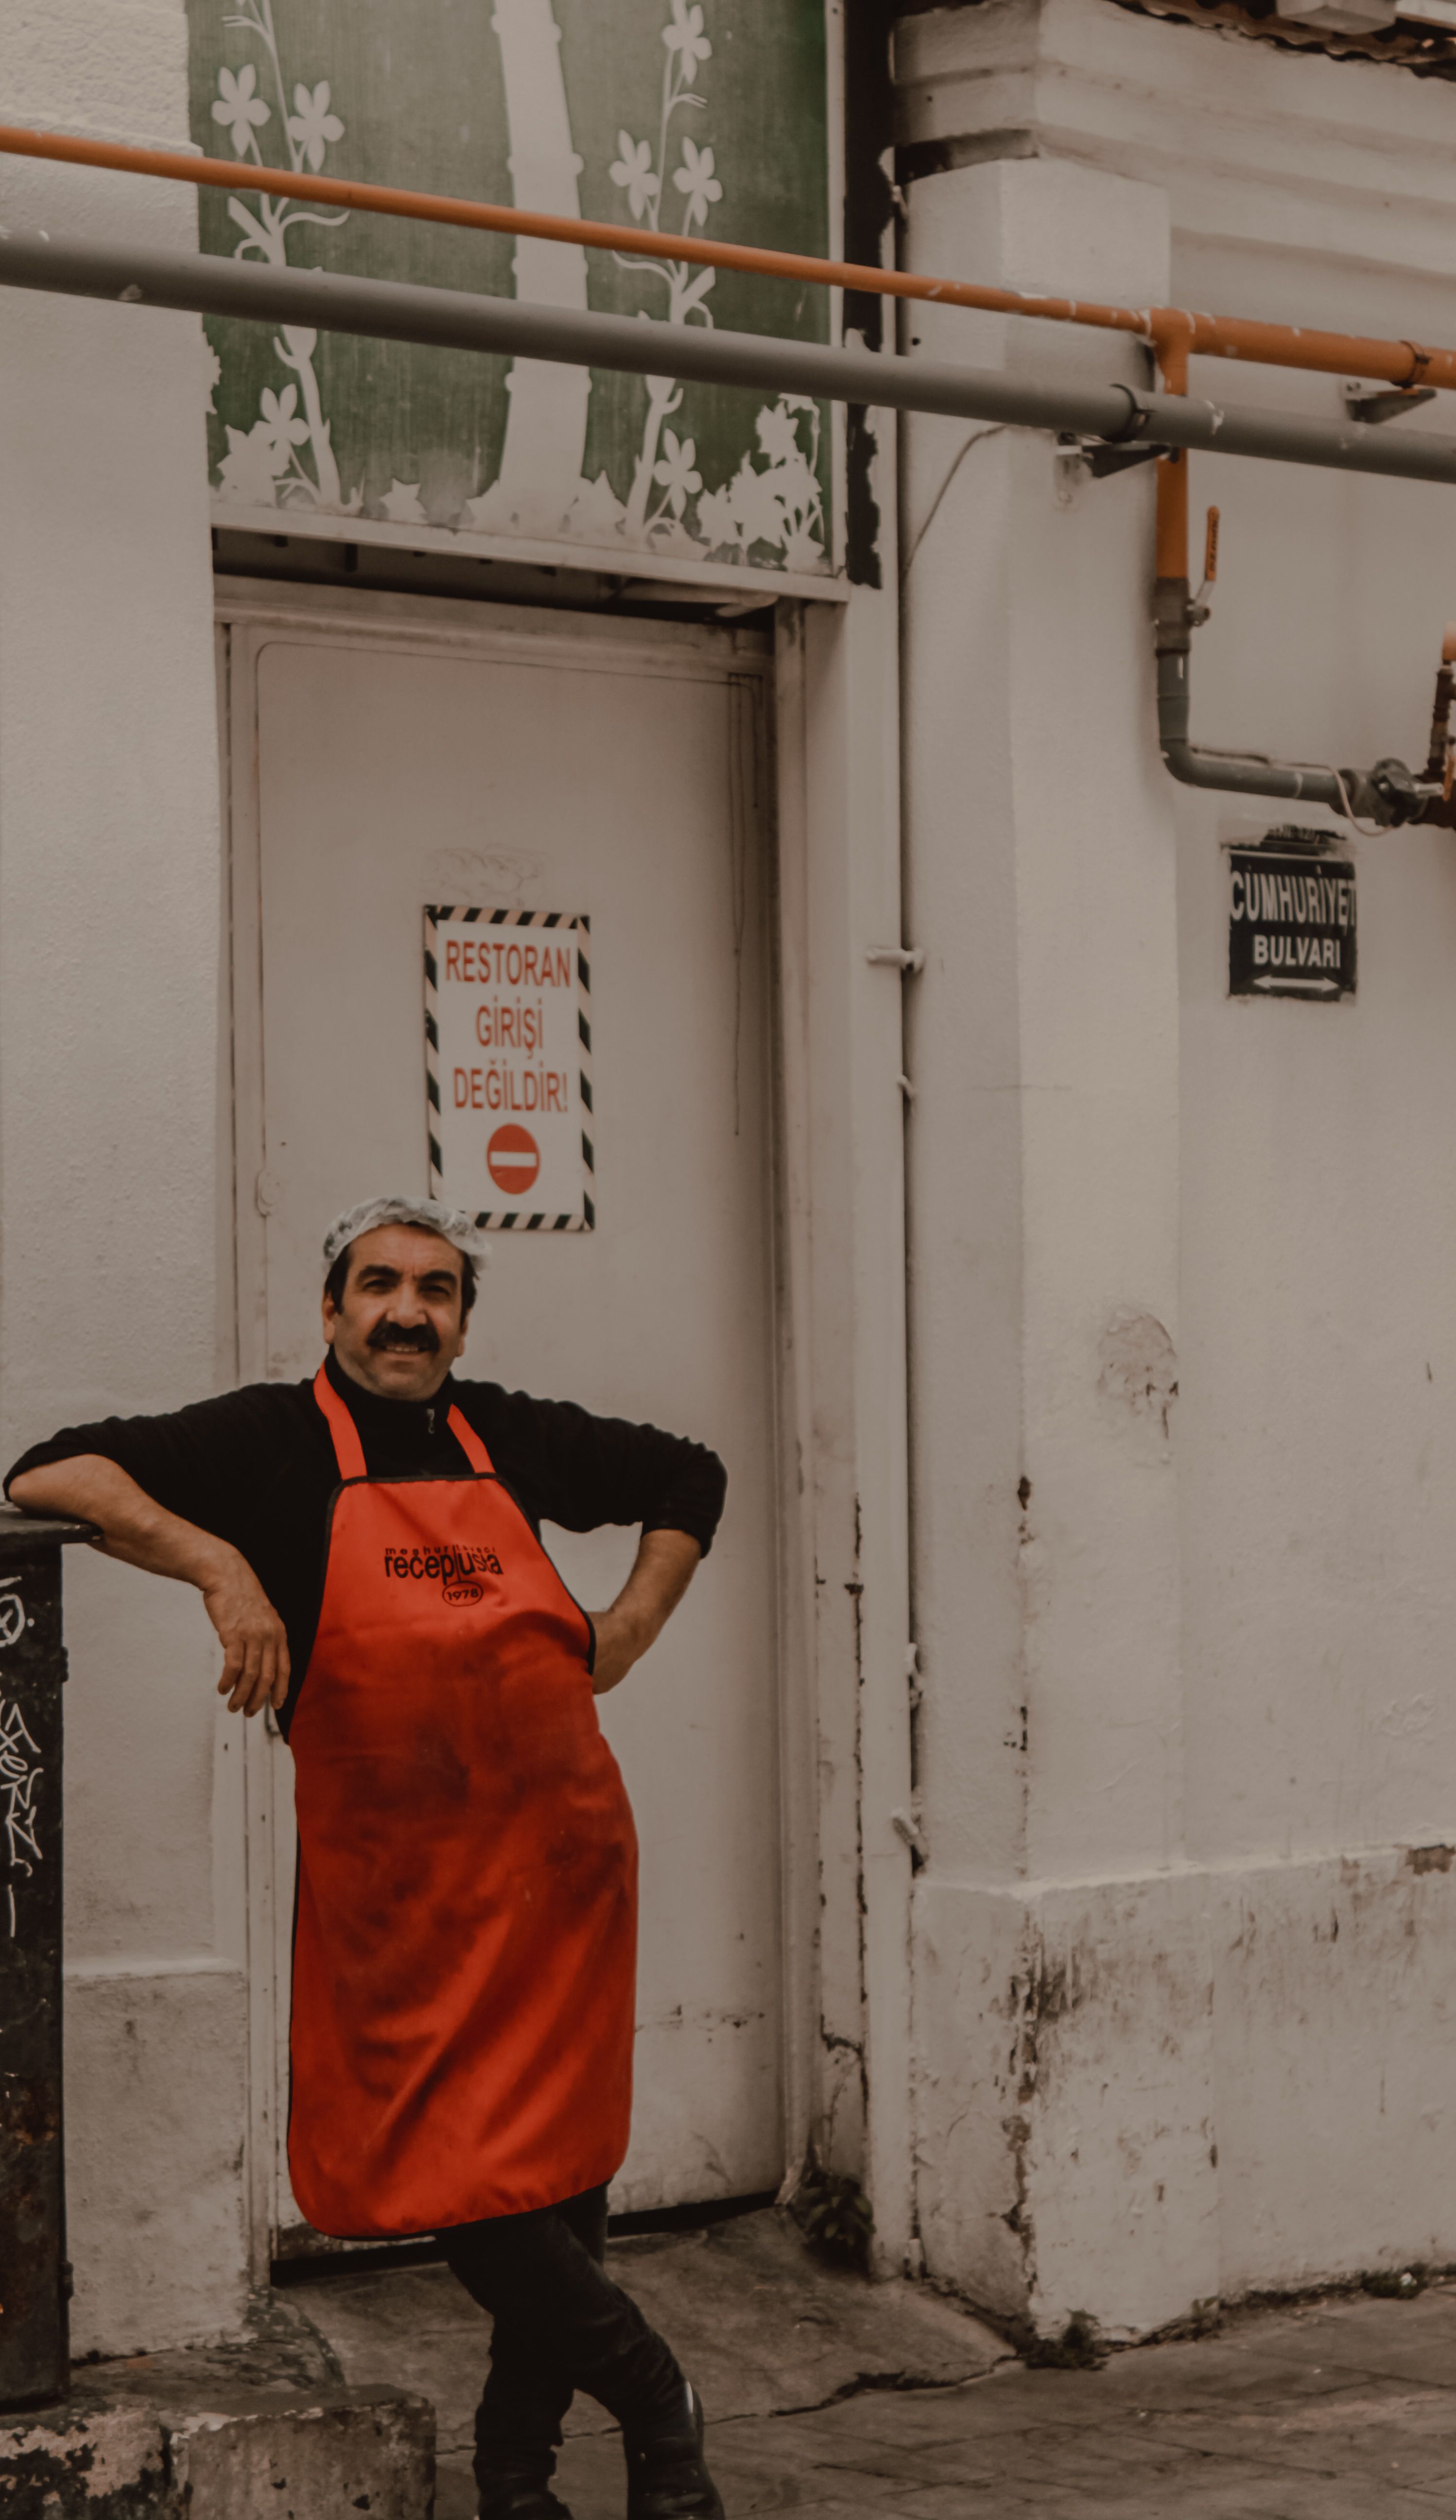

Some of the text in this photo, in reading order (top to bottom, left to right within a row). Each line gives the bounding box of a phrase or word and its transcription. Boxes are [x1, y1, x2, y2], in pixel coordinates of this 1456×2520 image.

[446, 940, 571, 987] RESTORAN
[1253, 934, 1340, 968] BULVARI
[476, 996, 543, 1059] GİRİŞİ
[454, 1058, 568, 1112] DEĞİLDİR!
[447, 1588, 479, 1600] 1978
